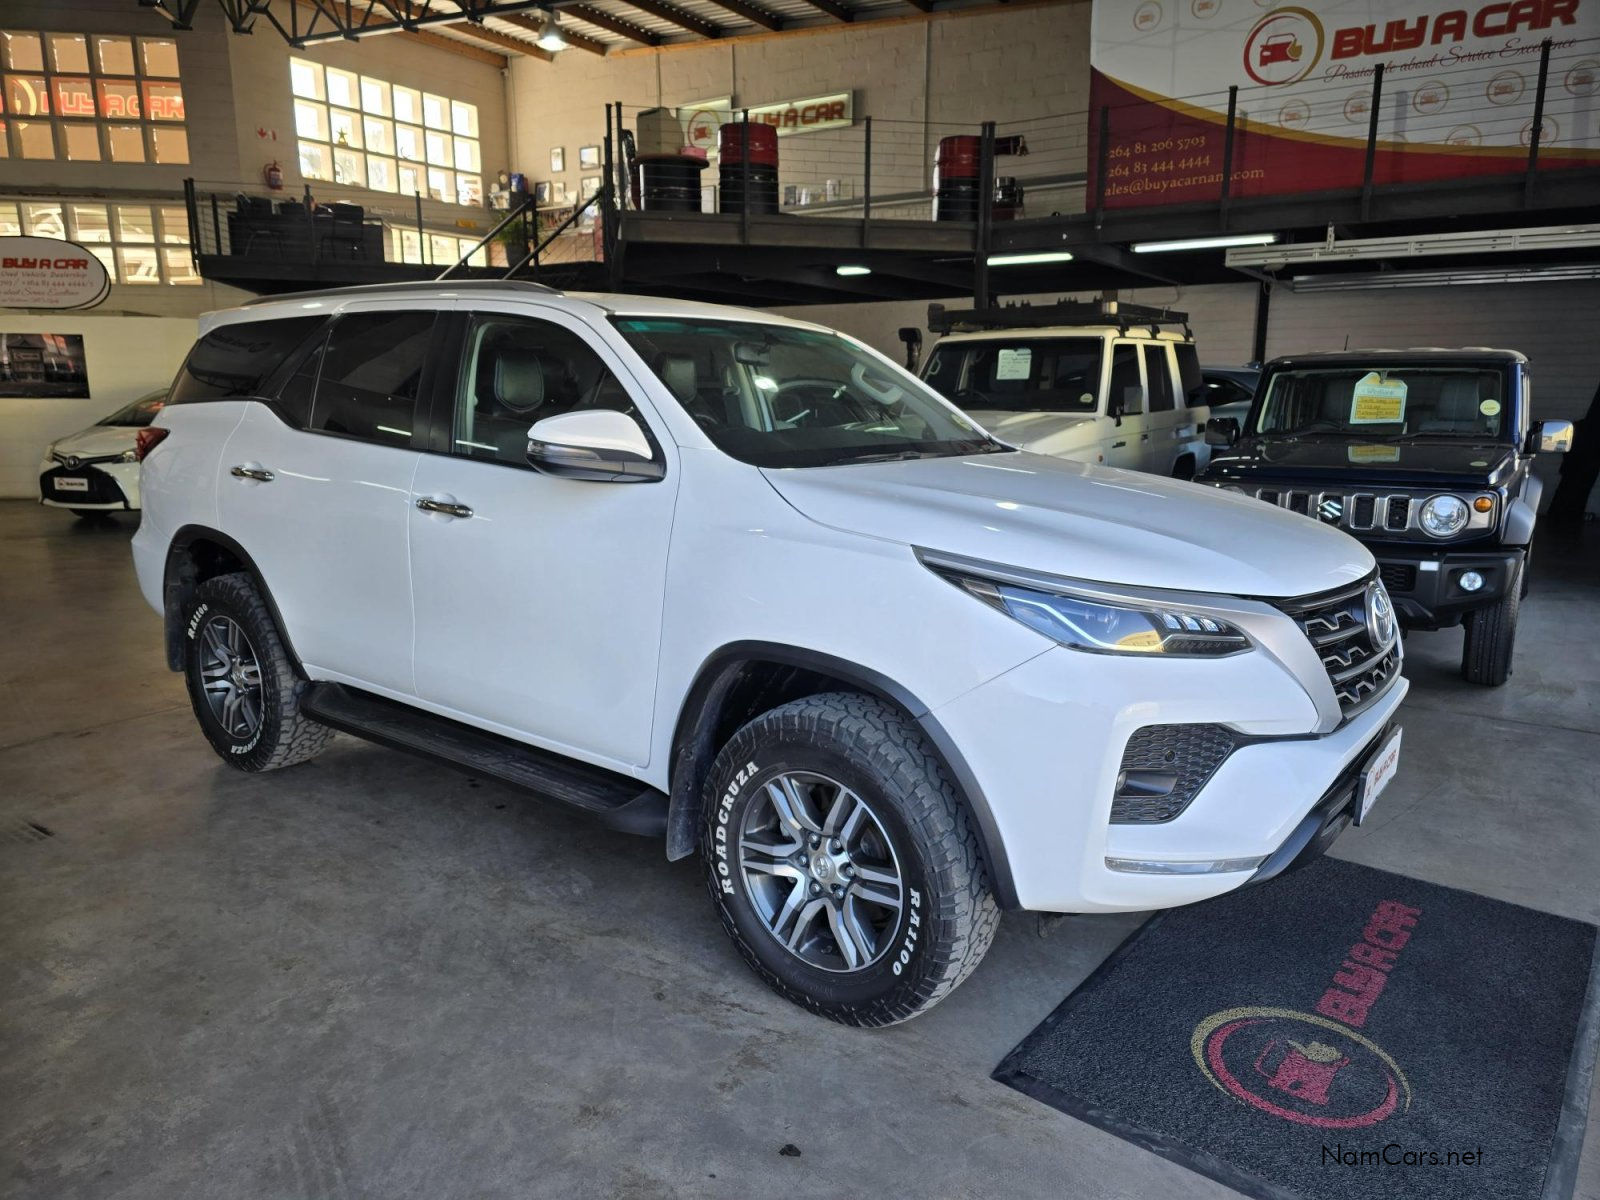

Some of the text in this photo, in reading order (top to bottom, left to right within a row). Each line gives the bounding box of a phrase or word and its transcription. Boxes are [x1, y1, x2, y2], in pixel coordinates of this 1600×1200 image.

[1330, 0, 1580, 60] BUY A CAR
[801, 100, 846, 126] CAR
[1106, 135, 1206, 159] 264 81 206 5703
[1106, 154, 1211, 177] 264 83 444 4444
[2, 257, 89, 270] BUY A CAR
[714, 761, 760, 896] ROADCRUZA
[892, 887, 922, 977] RA1100
